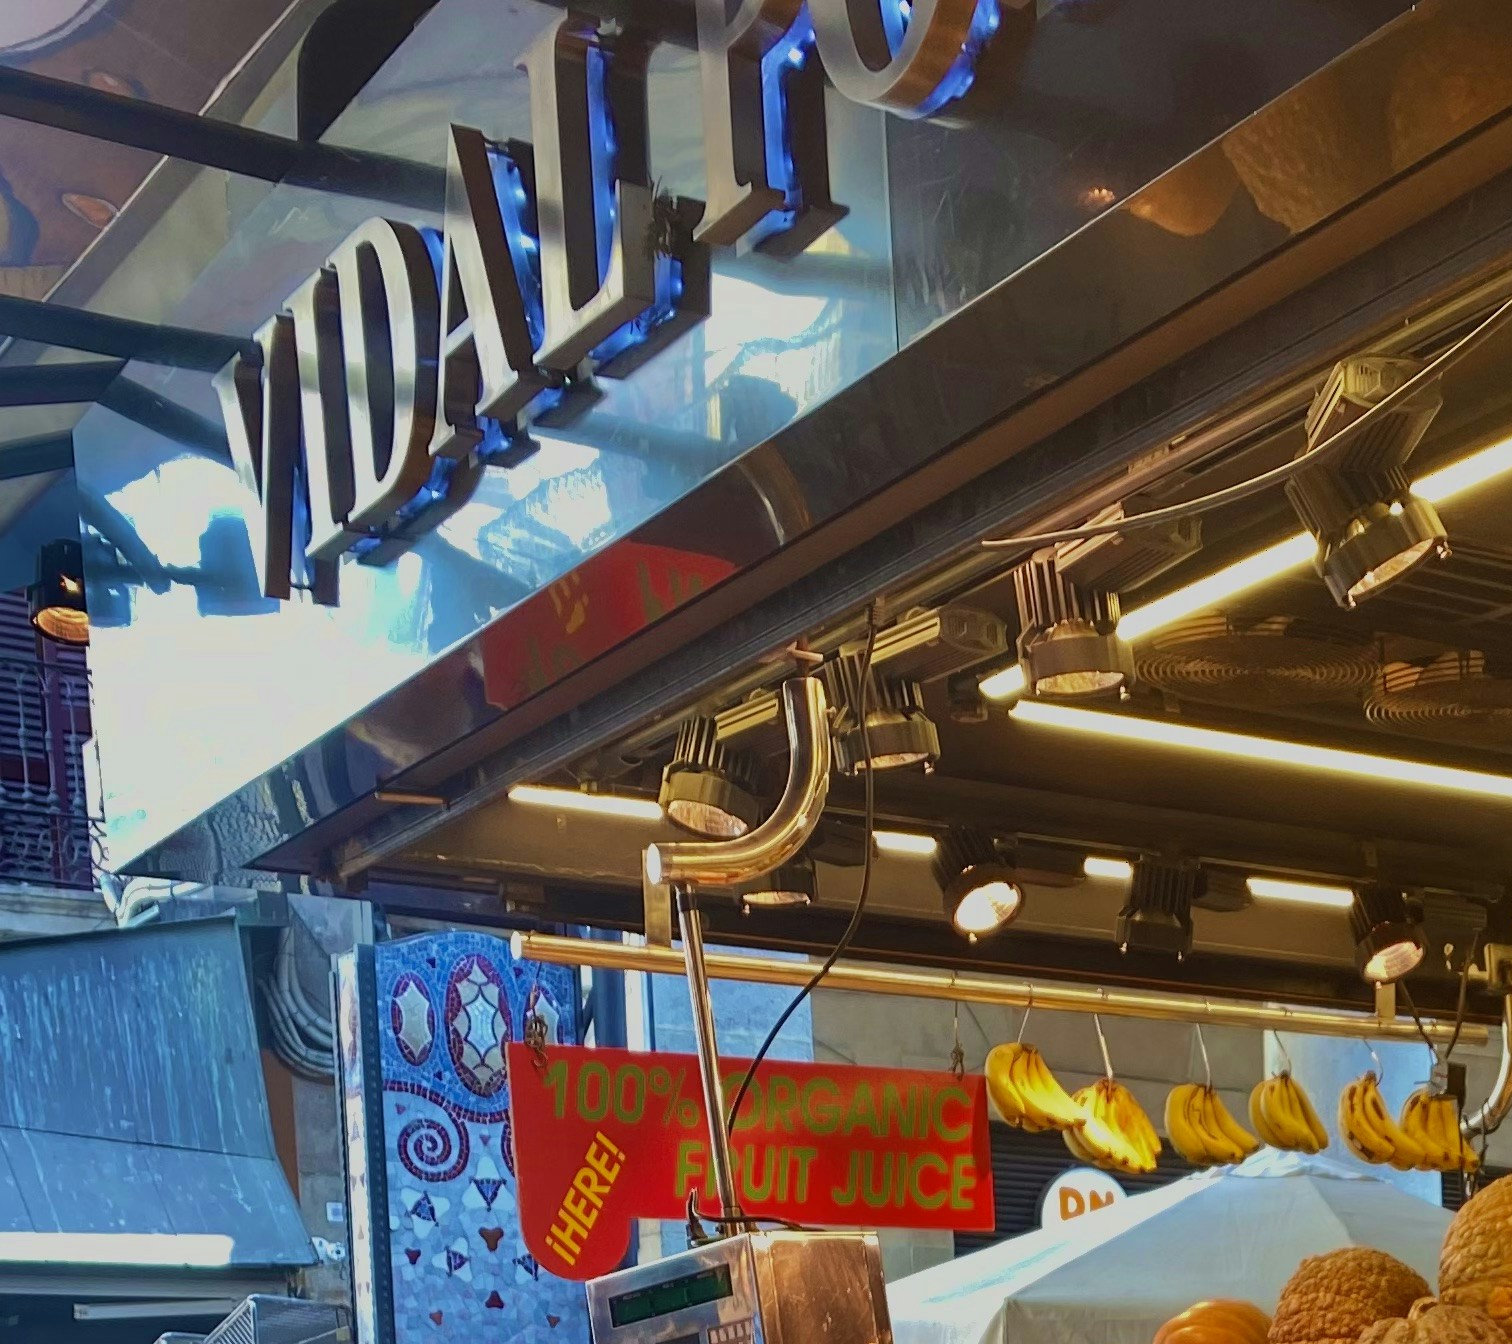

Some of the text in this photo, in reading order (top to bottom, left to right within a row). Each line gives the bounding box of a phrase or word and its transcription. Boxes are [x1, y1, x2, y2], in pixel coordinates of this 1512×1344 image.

[213, 8, 655, 600] VIDAL
[543, 1060, 974, 1142] 100% ORGANIC
[545, 1131, 626, 1266] ¡HERE!
[833, 1152, 976, 1210] JUICE
